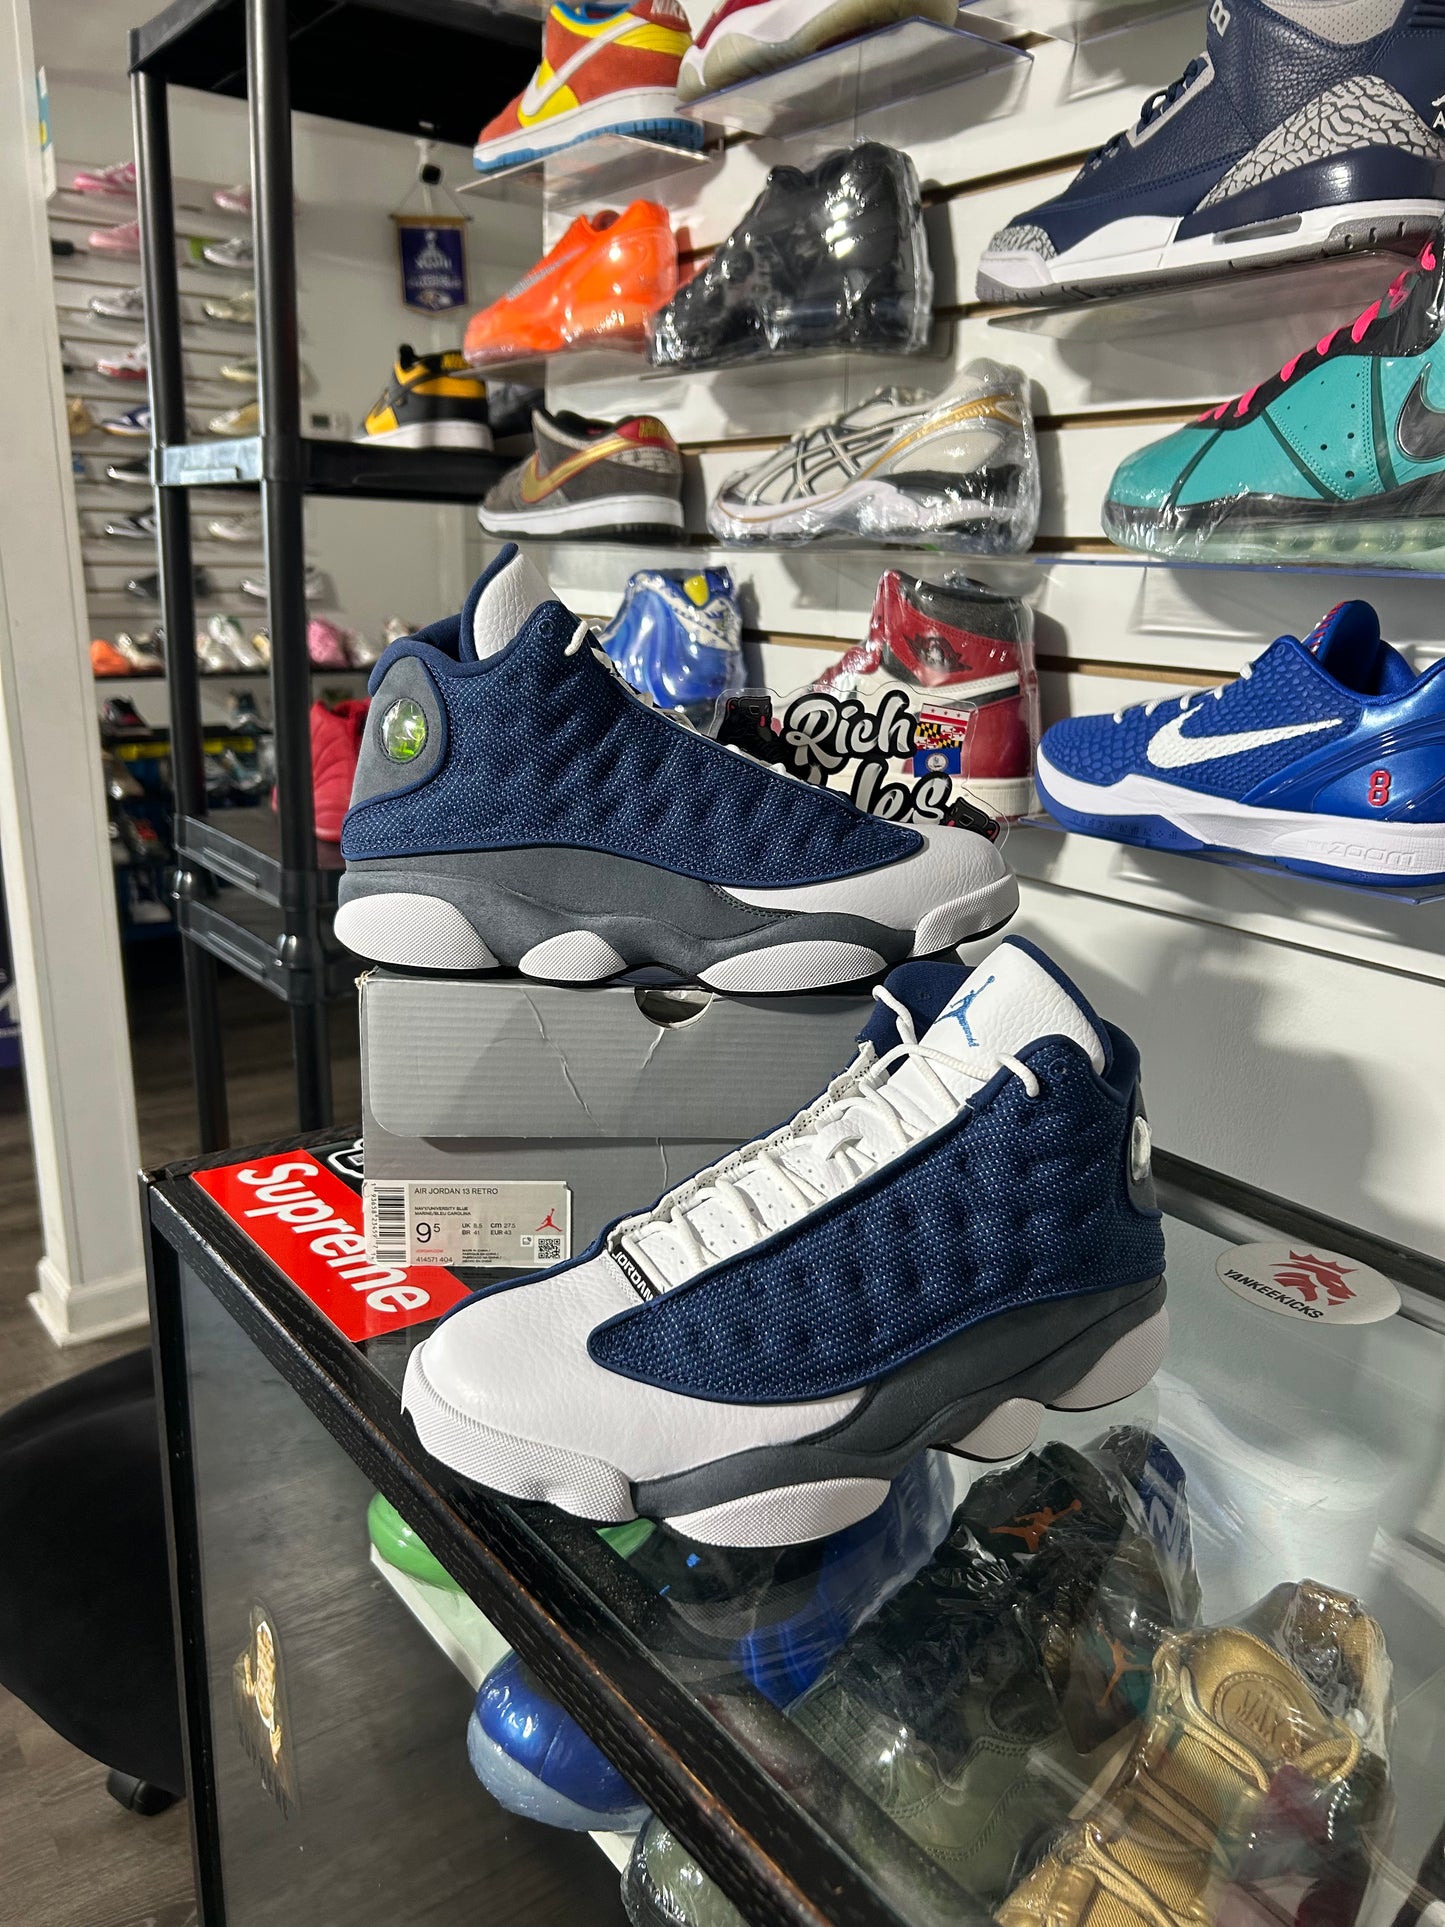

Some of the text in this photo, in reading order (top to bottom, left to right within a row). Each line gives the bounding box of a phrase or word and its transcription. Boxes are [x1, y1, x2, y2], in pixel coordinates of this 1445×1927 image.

[785, 694, 912, 771] Rich
[1367, 769, 1391, 807] 8
[414, 1187, 499, 1195] AIR JORDAN 13 RETRO
[237, 1163, 430, 1312] Supreme
[611, 1251, 654, 1301] JORDAN
[1223, 1268, 1325, 1319] YANKEEKICKS
